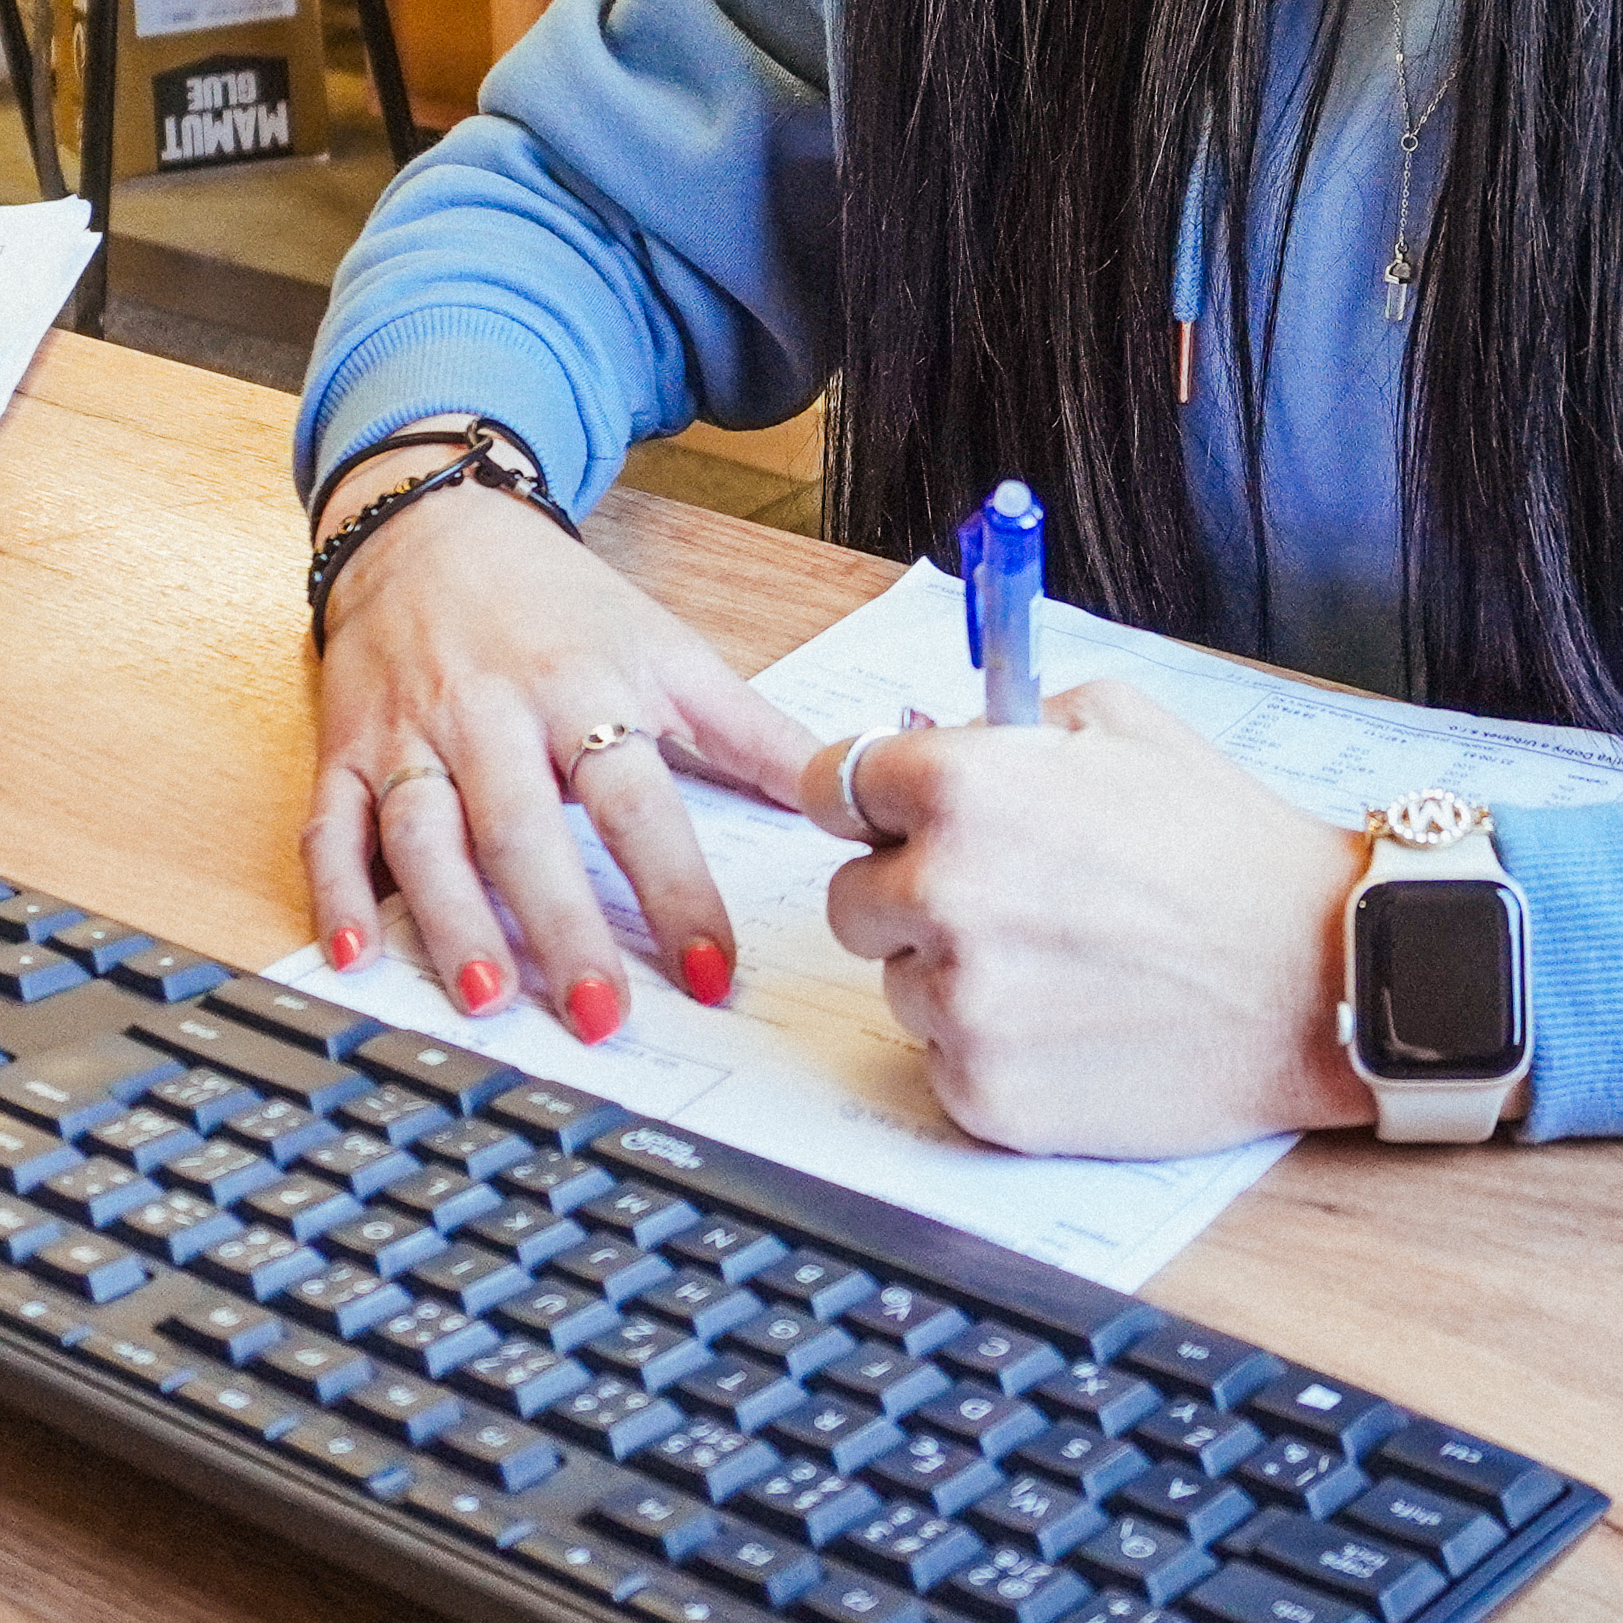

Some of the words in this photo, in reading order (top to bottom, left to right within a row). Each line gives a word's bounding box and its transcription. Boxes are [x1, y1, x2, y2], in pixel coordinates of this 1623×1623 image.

[185, 69, 257, 111] GLUE
[161, 100, 290, 161] MAMUT
[617, 1196, 651, 1213] M
[362, 1223, 394, 1239] O
[505, 1214, 532, 1230] K
[704, 1229, 735, 1248] N
[590, 1249, 618, 1263] J
[796, 1266, 822, 1282] B
[677, 1284, 708, 1302] H
[534, 1295, 566, 1313] U
[769, 1321, 799, 1338] G
[980, 1339, 1010, 1357] C
[718, 1373, 745, 1390] T
[960, 1401, 992, 1419] D
[1172, 1405, 1196, 1422] Y
[815, 1412, 844, 1430] R
[1063, 1440, 1090, 1458] S
[1169, 1480, 1196, 1499] A
[1012, 1492, 1049, 1516] W
[1391, 1501, 1440, 1525] shift
[1122, 1533, 1156, 1558] Q
